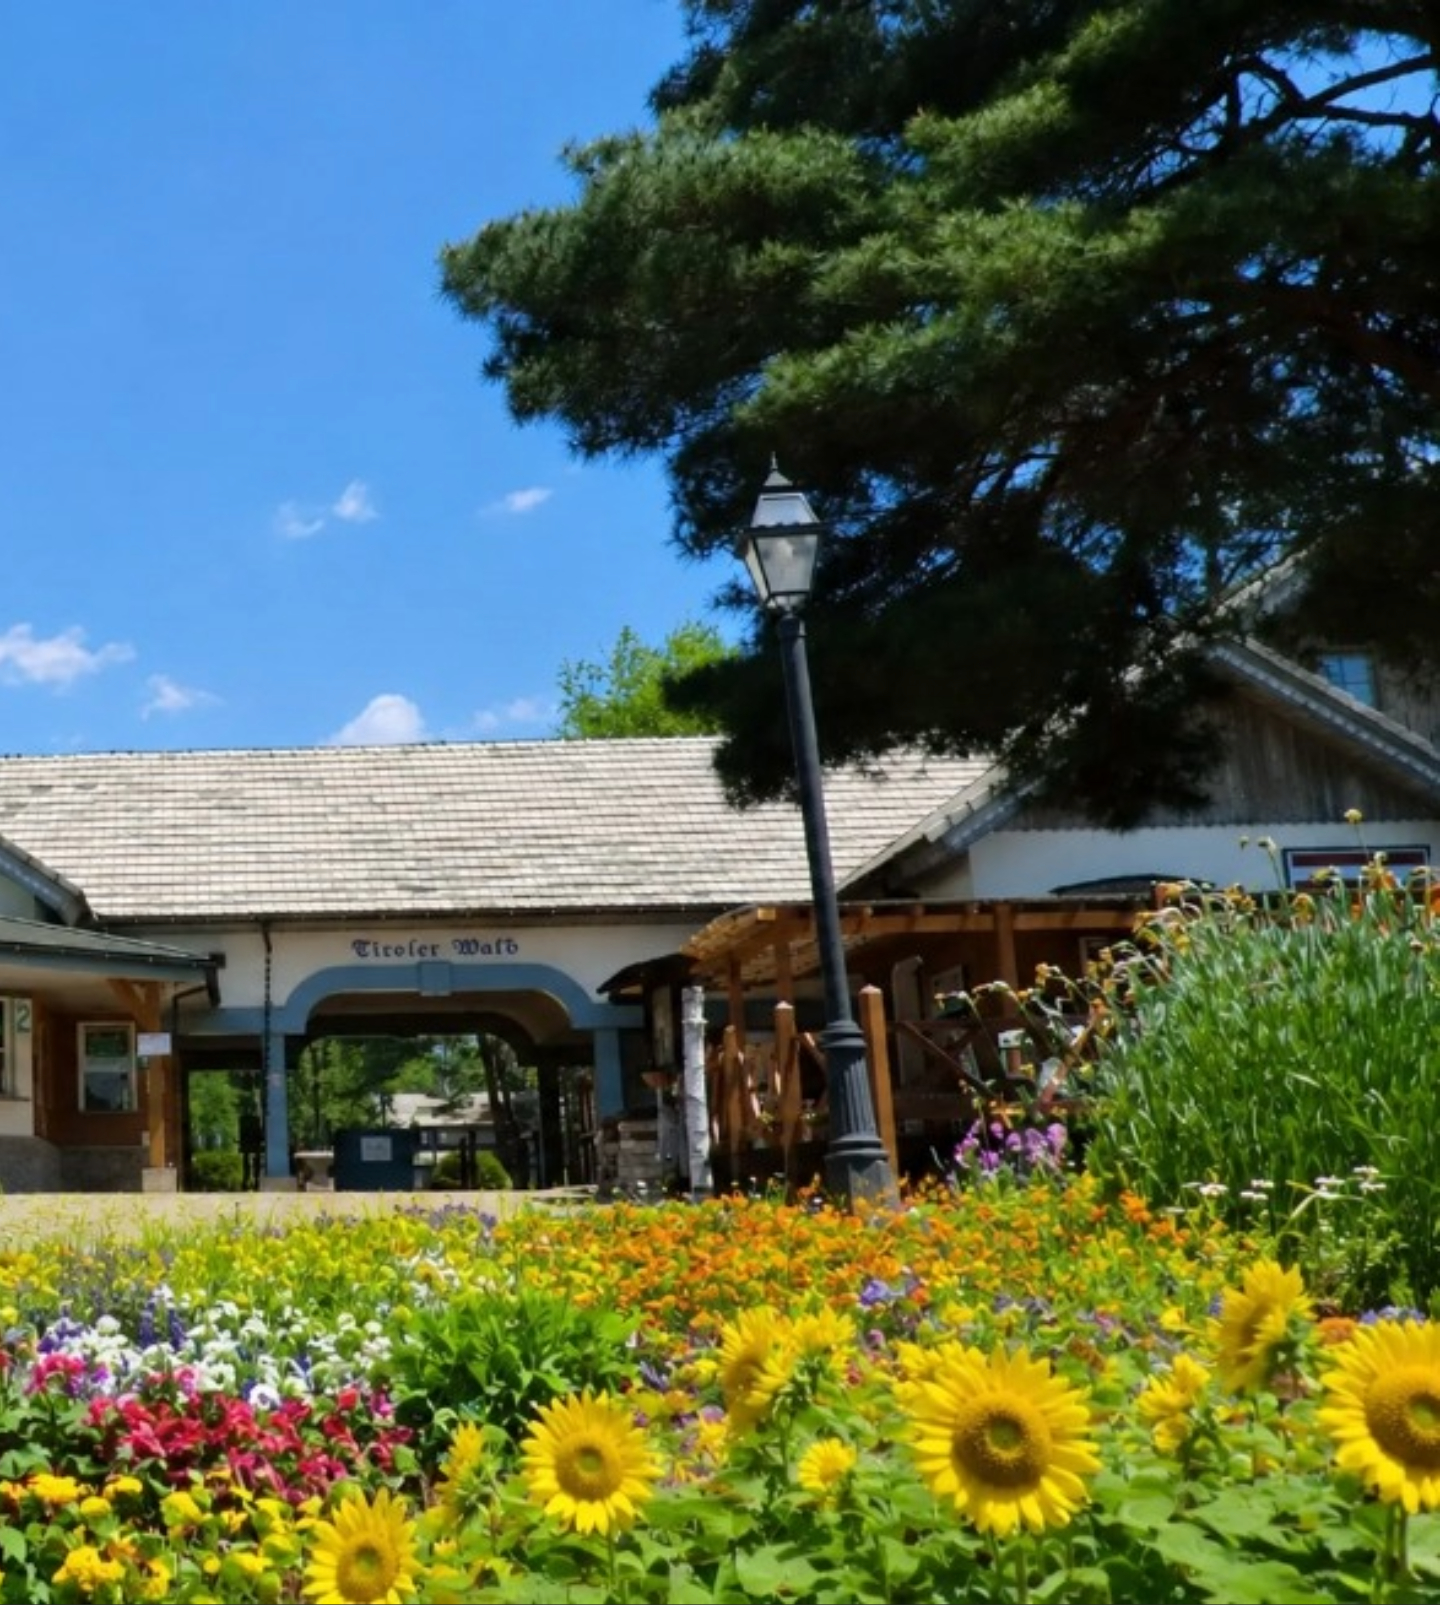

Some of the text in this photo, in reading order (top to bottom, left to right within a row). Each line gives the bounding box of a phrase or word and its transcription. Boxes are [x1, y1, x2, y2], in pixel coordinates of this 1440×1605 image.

[351, 937, 519, 958] Tiroler Wald
[17, 1003, 31, 1033] 2
